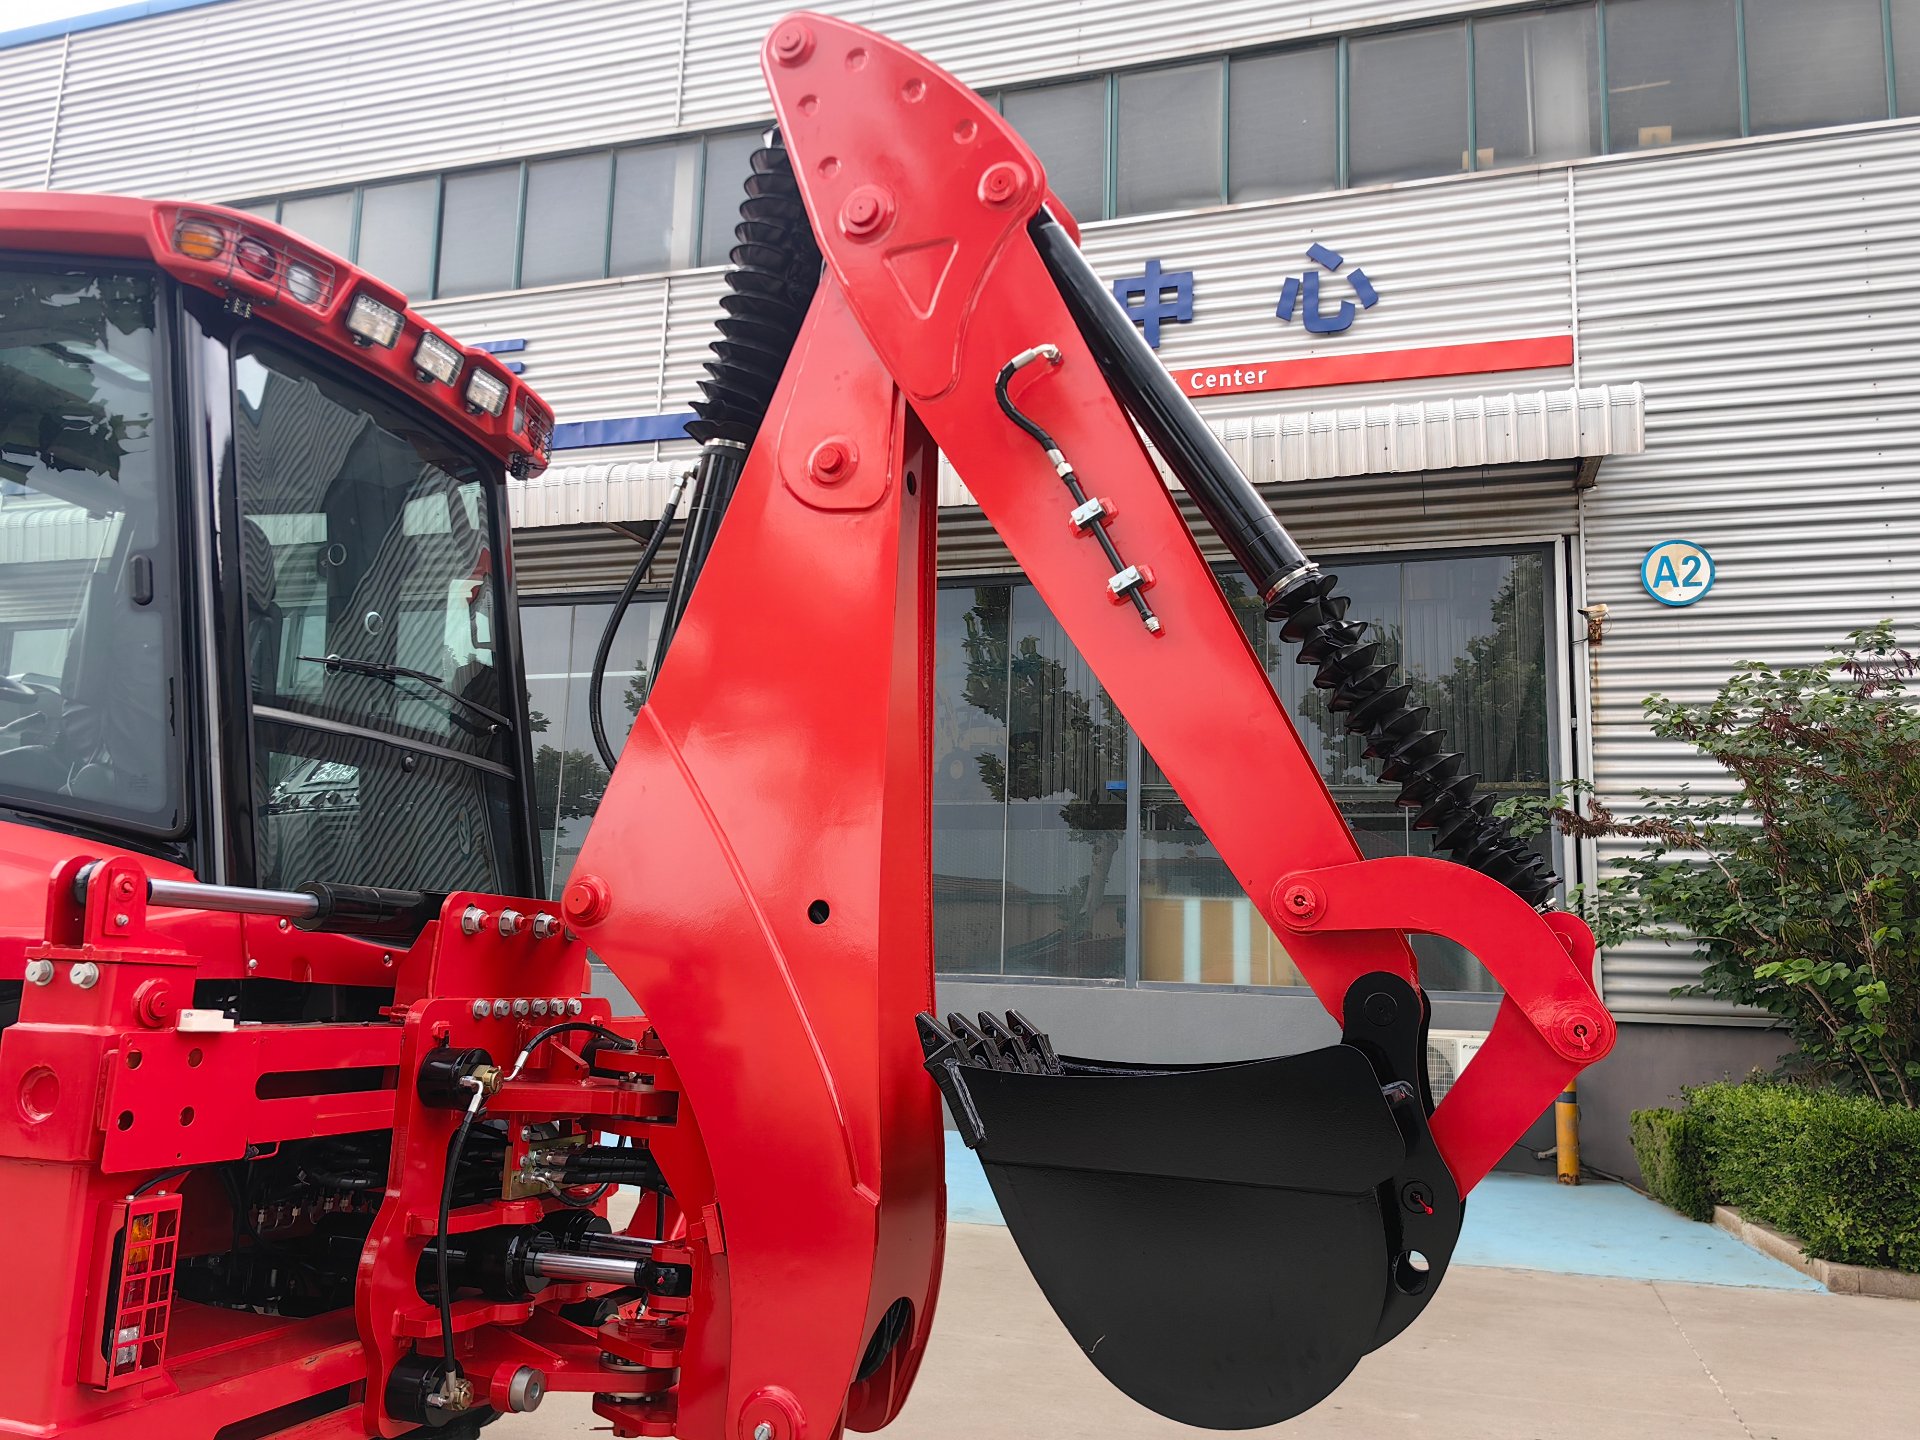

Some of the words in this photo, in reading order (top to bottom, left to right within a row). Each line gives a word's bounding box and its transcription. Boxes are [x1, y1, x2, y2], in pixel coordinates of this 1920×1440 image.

[1113, 242, 1379, 349] 中心
[1190, 369, 1268, 390] Center
[1652, 555, 1703, 589] A2
